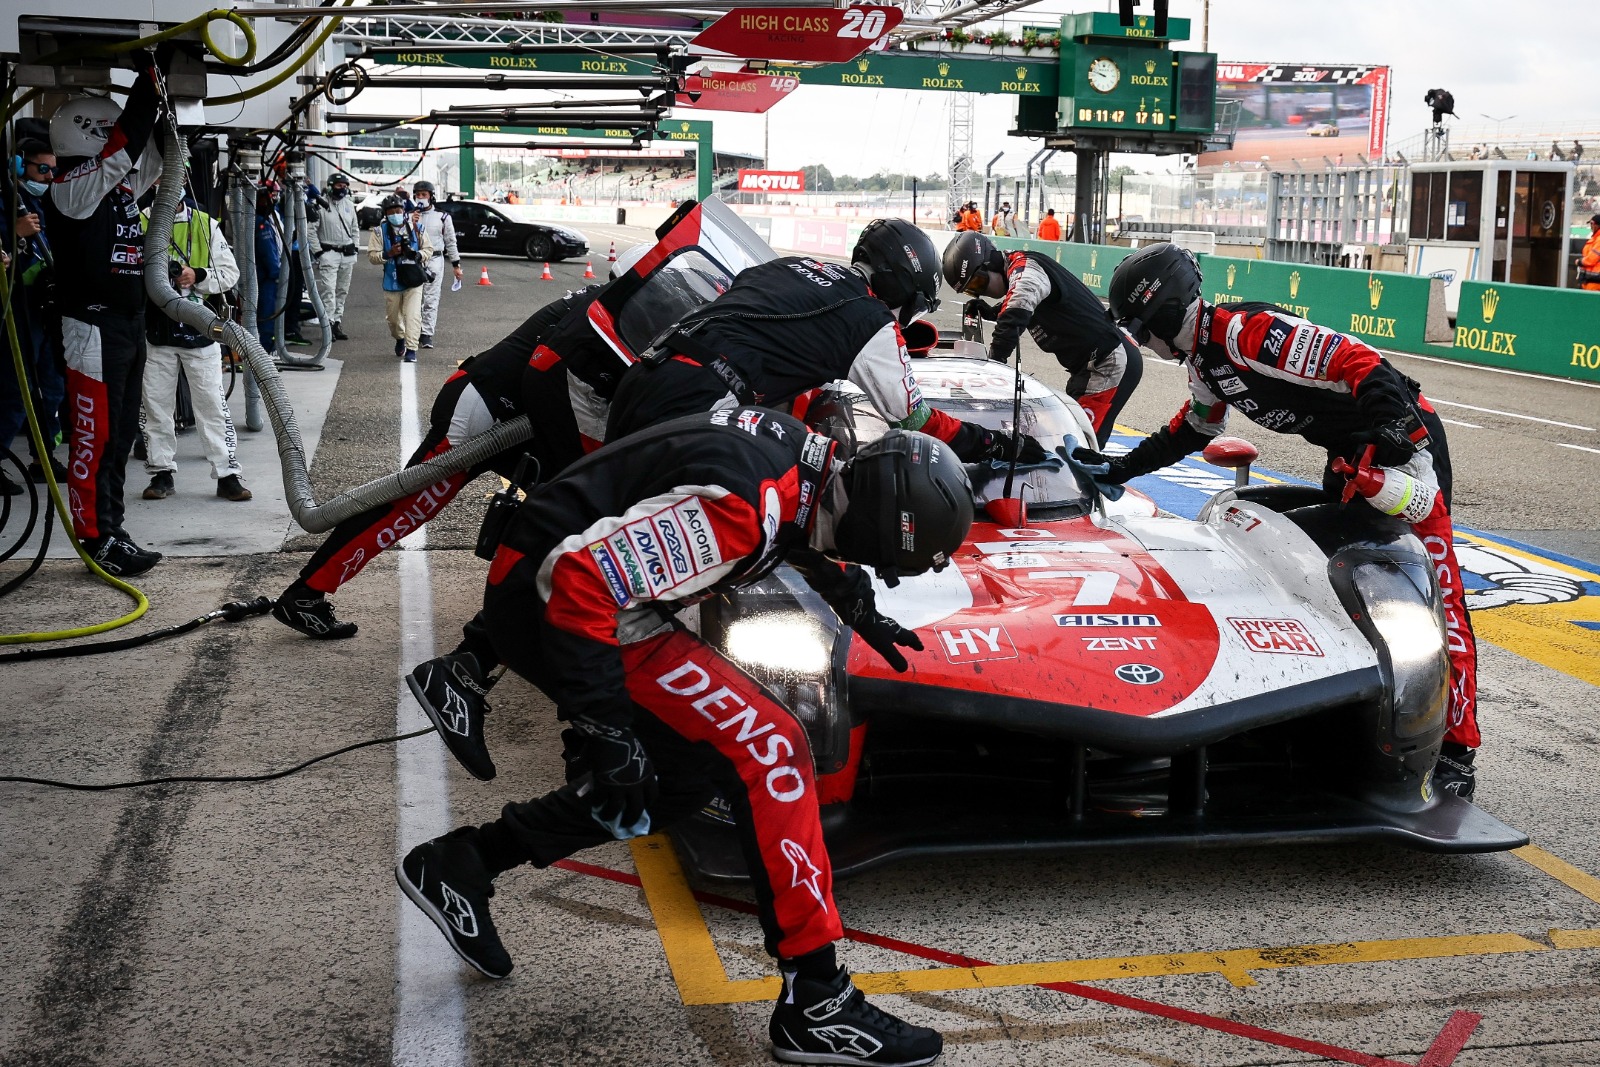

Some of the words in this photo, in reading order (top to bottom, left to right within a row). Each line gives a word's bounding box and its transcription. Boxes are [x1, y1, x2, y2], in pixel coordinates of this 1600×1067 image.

[740, 14, 778, 31] HIGH
[783, 16, 829, 33] CLASS
[836, 9, 886, 40] 20
[768, 34, 805, 43] RACING
[397, 53, 445, 64] ROLEX
[490, 56, 538, 69] ROLEX
[581, 60, 628, 73] ROLEX
[841, 73, 885, 85] ROLEX
[1217, 66, 1245, 79] TUL
[1292, 70, 1329, 82] 300V
[702, 79, 725, 90] HIGH
[728, 81, 757, 93] CLASS
[770, 78, 796, 92] 49
[922, 77, 964, 89] ROLEX
[1001, 81, 1040, 93] ROLEX
[1131, 75, 1169, 87] ROLEX
[1136, 111, 1149, 124] 17
[538, 127, 568, 135] ROLEX
[671, 132, 700, 140] ROLEX
[742, 174, 801, 191] MOTUL
[788, 264, 833, 288] DENSO
[1083, 273, 1102, 288] ROLEX
[1127, 277, 1150, 304] uvex
[1350, 313, 1396, 338] ROLEX
[1289, 328, 1310, 370] Acronis
[1455, 326, 1517, 356] ROLEX
[916, 376, 1009, 389] ENSO
[73, 393, 94, 480] DENSO
[376, 480, 451, 549] DENSO
[902, 512, 910, 532] GR
[1245, 517, 1262, 533] 7
[683, 508, 714, 565] Acronis
[658, 519, 688, 574] RAYS
[614, 537, 646, 594] HAYASHI
[634, 529, 667, 587] ADVICS
[602, 560, 626, 599] MICHELIN
[1028, 571, 1120, 607] 7
[1058, 614, 1160, 627] AISIN
[1235, 618, 1300, 634] HYPER
[945, 627, 1002, 657] HY
[1081, 636, 1158, 651] ZENT
[1249, 628, 1315, 653] CAR
[656, 659, 805, 803] DENSO
